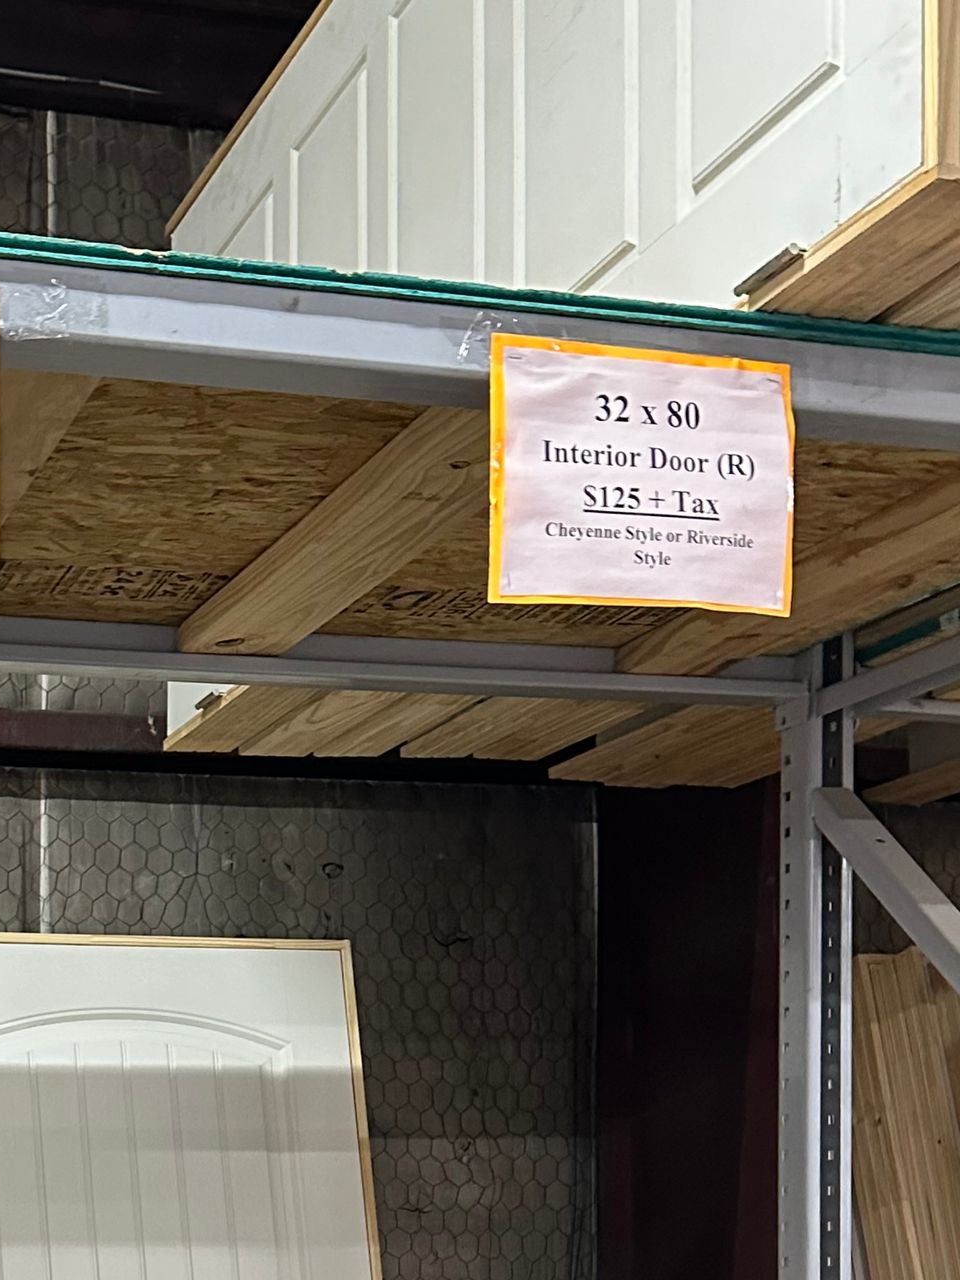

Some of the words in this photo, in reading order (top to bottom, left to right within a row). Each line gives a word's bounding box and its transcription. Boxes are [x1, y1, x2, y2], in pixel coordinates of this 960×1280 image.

[594, 394, 630, 424] 32
[640, 404, 659, 426] x
[666, 400, 701, 430] 80
[541, 439, 642, 468] Interior
[648, 446, 710, 474] Door
[716, 453, 756, 481] (R)
[648, 490, 666, 510] +
[672, 490, 720, 516] Tax
[544, 521, 622, 542] Cheyenne
[624, 526, 663, 545] Style
[666, 531, 684, 544] or
[686, 529, 754, 550] Riverside
[633, 549, 672, 569] Style
